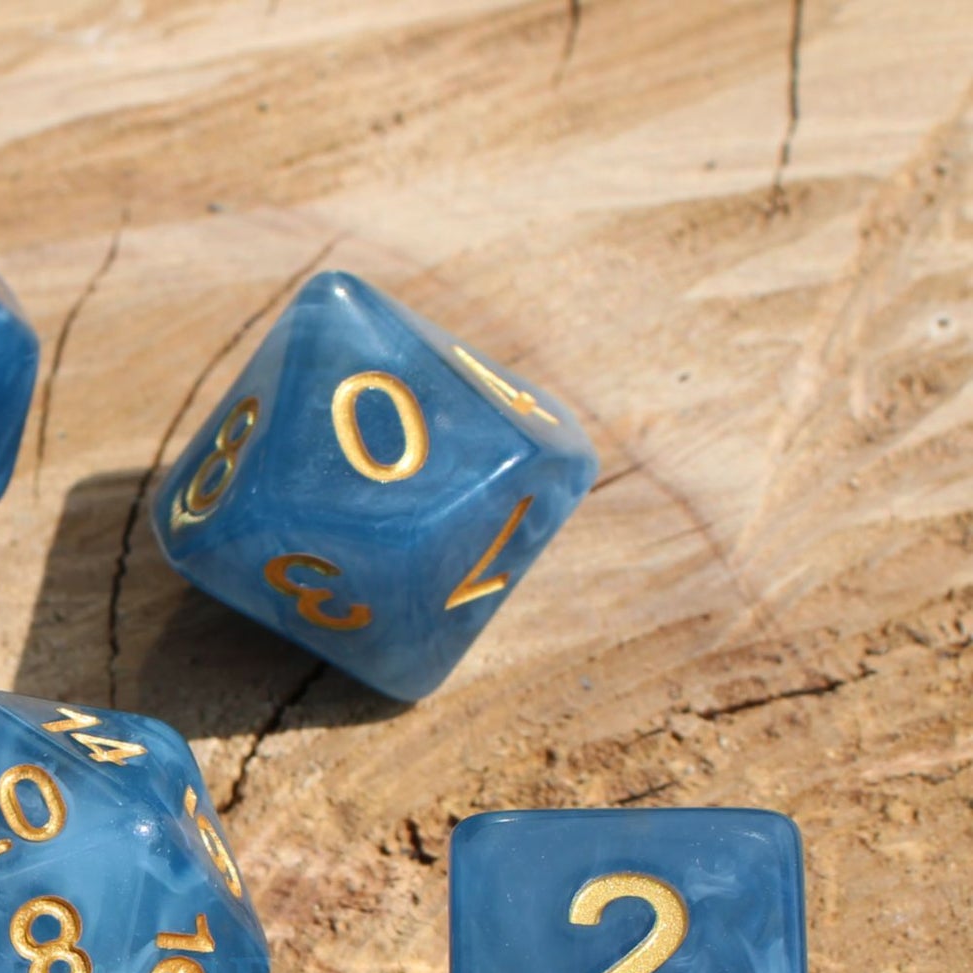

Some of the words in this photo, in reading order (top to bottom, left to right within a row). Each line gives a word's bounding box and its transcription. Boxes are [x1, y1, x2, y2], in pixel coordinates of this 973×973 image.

[185, 396, 259, 511] 8
[331, 370, 430, 483] 0
[264, 552, 373, 631] 3
[40, 706, 149, 767] 14
